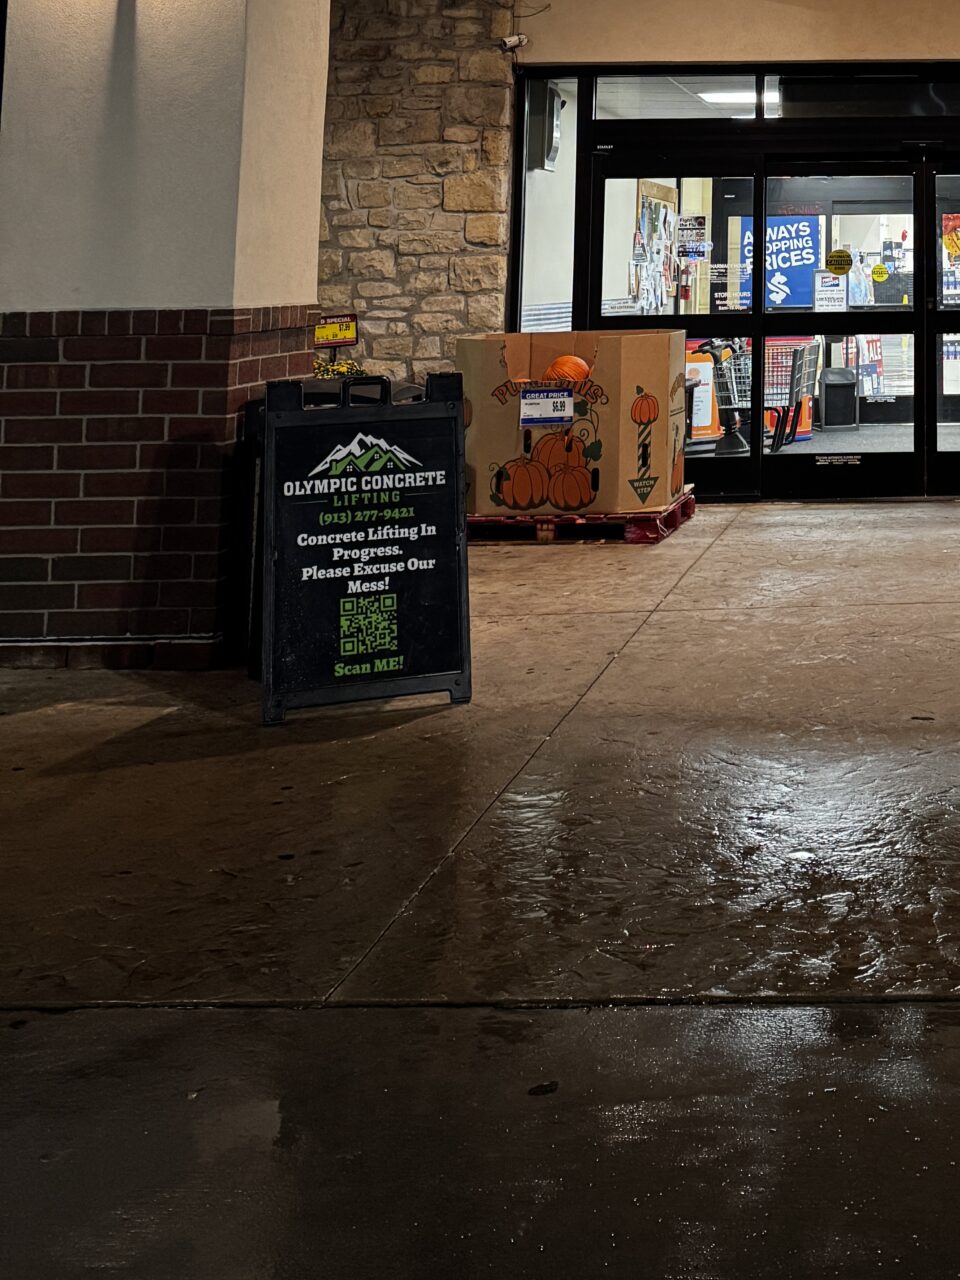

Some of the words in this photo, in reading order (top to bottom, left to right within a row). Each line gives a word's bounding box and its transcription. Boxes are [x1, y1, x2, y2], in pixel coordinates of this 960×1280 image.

[743, 222, 811, 245] AWAYS
[744, 237, 813, 256] COPPING
[552, 400, 566, 413] $6.99
[283, 477, 357, 496] OLYMPIC
[361, 471, 446, 490] CONCRETE
[333, 491, 401, 507] LIFTING
[319, 510, 352, 526] (913)
[354, 507, 415, 521] 277-9421
[296, 529, 365, 546] Concrete
[367, 525, 418, 540] Lifting
[420, 523, 437, 535] In
[332, 545, 403, 562] Progress.
[301, 565, 351, 580] Please
[352, 560, 405, 576] Excuse
[407, 558, 436, 570] Our
[347, 576, 390, 594] Mess!
[334, 662, 371, 677] Scan
[373, 655, 404, 673] ME!
